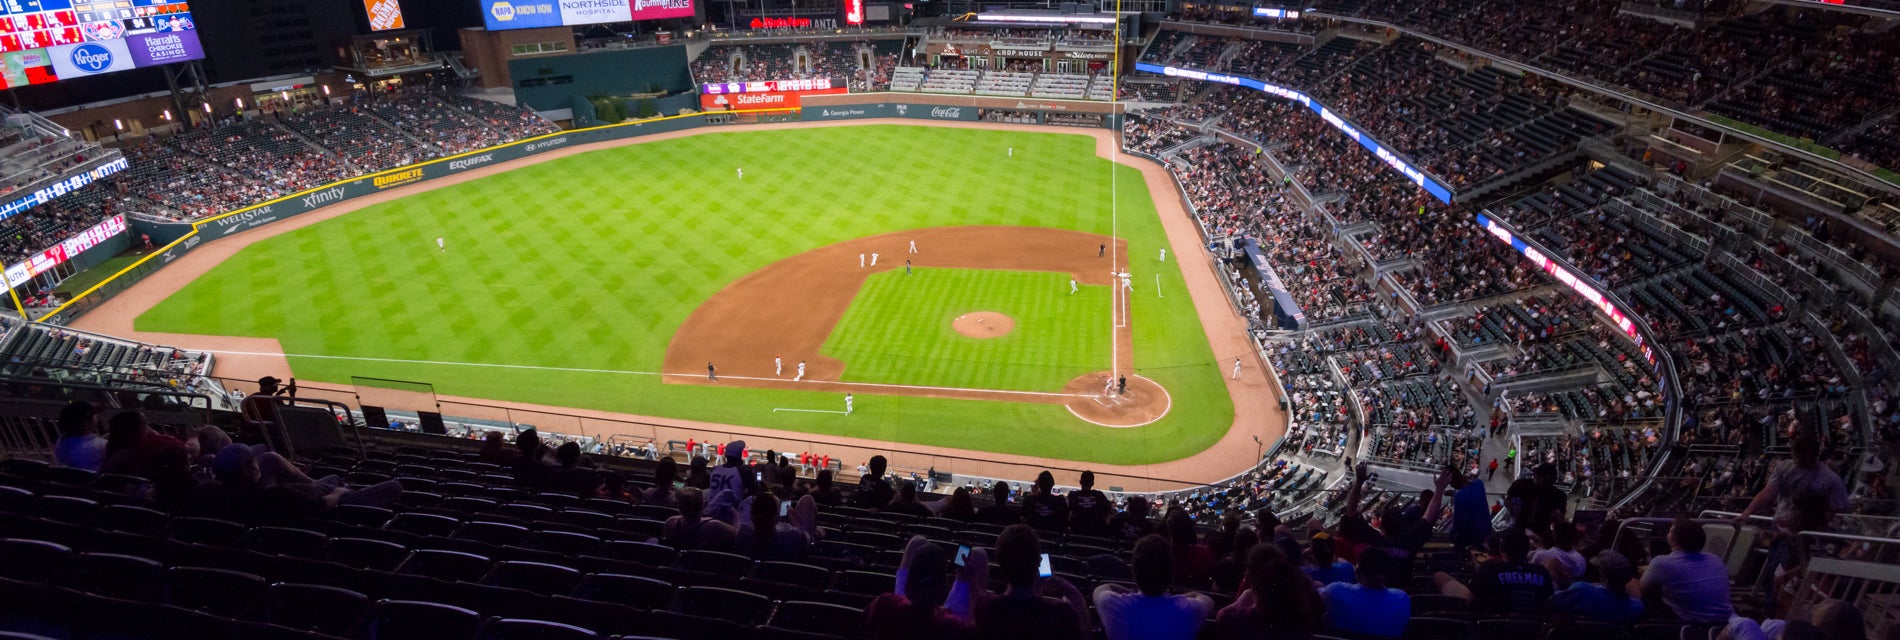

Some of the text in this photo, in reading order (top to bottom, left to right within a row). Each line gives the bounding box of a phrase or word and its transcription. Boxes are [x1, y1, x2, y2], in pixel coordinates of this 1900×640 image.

[494, 6, 513, 16] NAPA
[516, 4, 553, 15] KNOW HOW
[562, 0, 626, 9] NORTHSIDE
[384, 8, 401, 28] DEPOT
[148, 42, 183, 53] CHEROKEE
[150, 48, 185, 58] CASINOS
[74, 48, 110, 69] Kroger
[830, 109, 850, 117] Georgia
[537, 137, 567, 149] HYUNDAI
[449, 153, 493, 170] EQUIFAX
[373, 168, 424, 187] QUIKRETE
[302, 186, 345, 208] xfinity
[217, 205, 273, 227] WELLSTAR
[1498, 571, 1545, 587] FREEMAN
